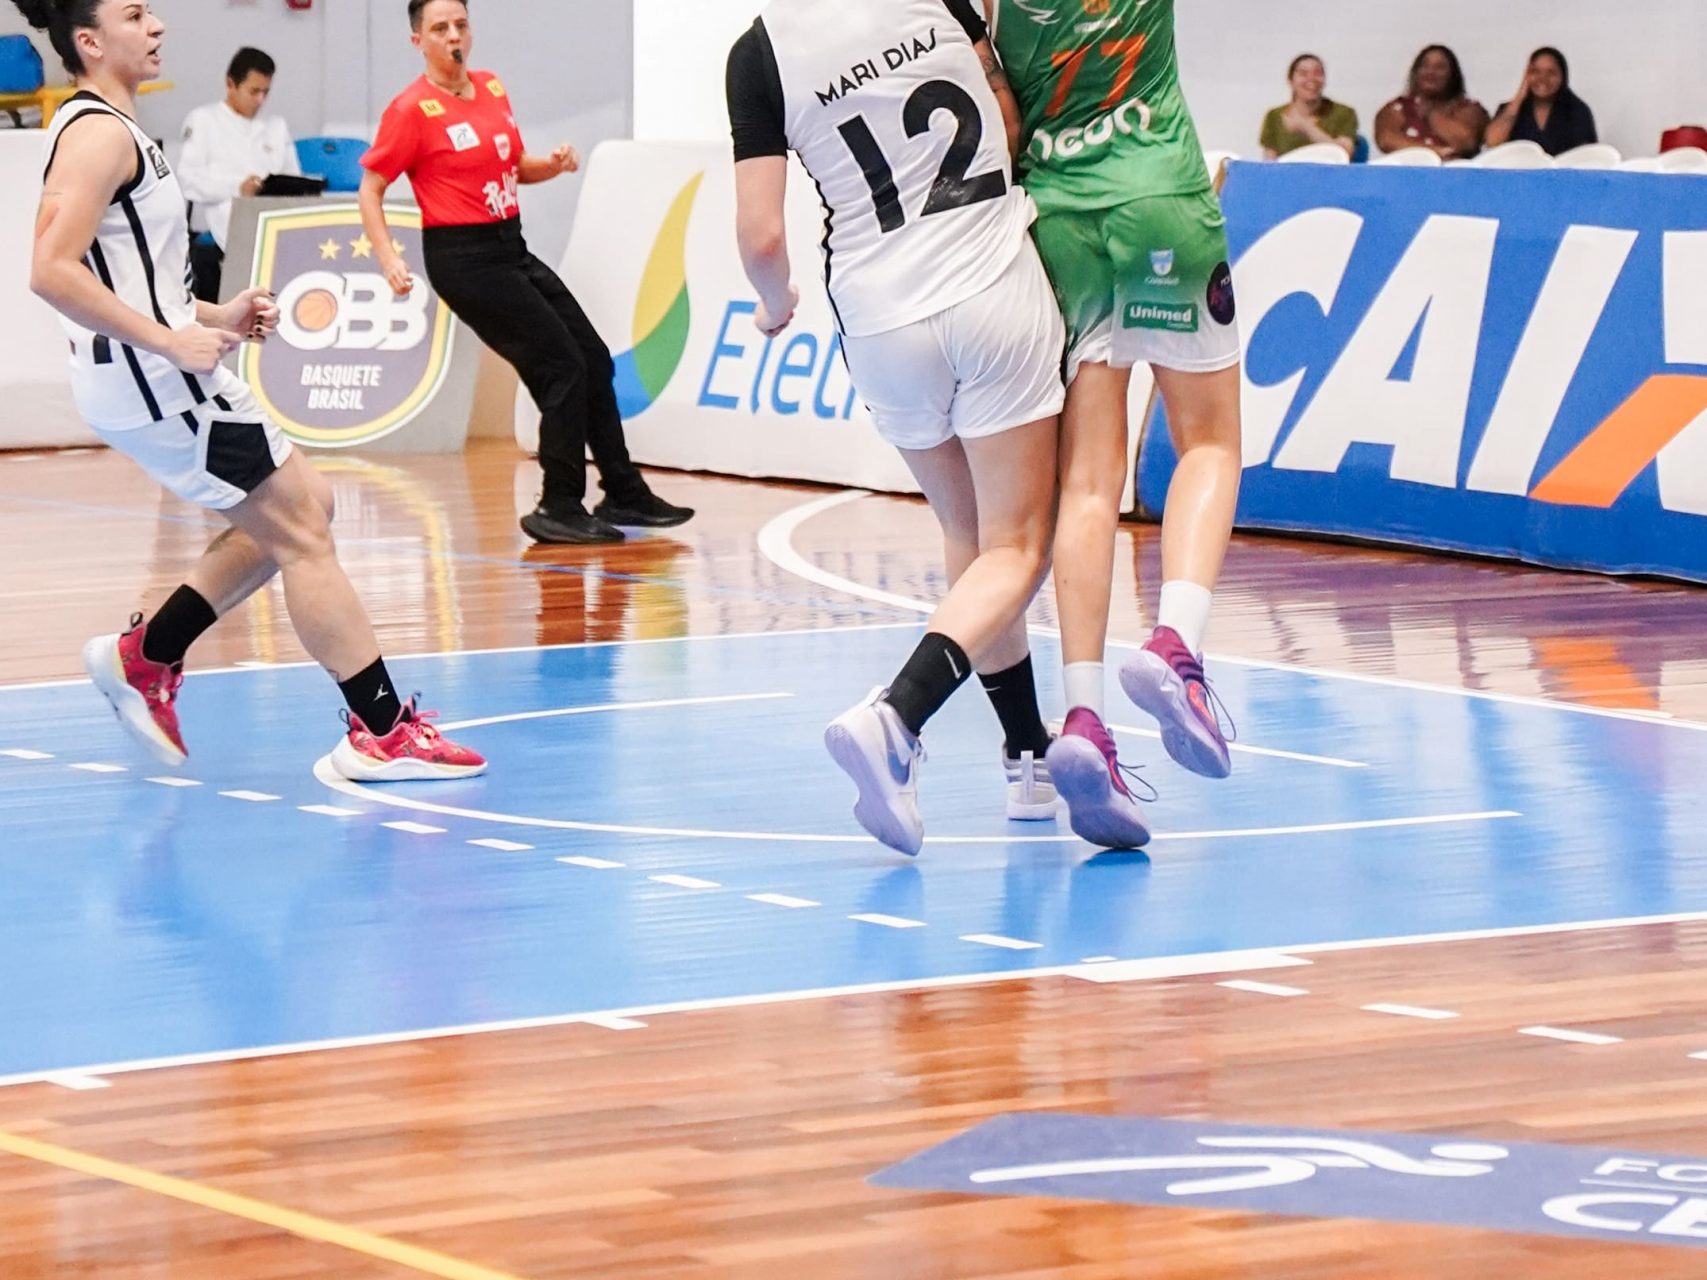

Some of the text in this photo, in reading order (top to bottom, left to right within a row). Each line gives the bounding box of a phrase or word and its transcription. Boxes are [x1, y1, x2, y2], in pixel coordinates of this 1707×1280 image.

[815, 28, 937, 106] MARI DIAS
[837, 80, 1007, 233] 12
[1129, 306, 1192, 323] Unimed
[301, 364, 383, 389] BASQUETE
[307, 388, 364, 410] BRASIL
